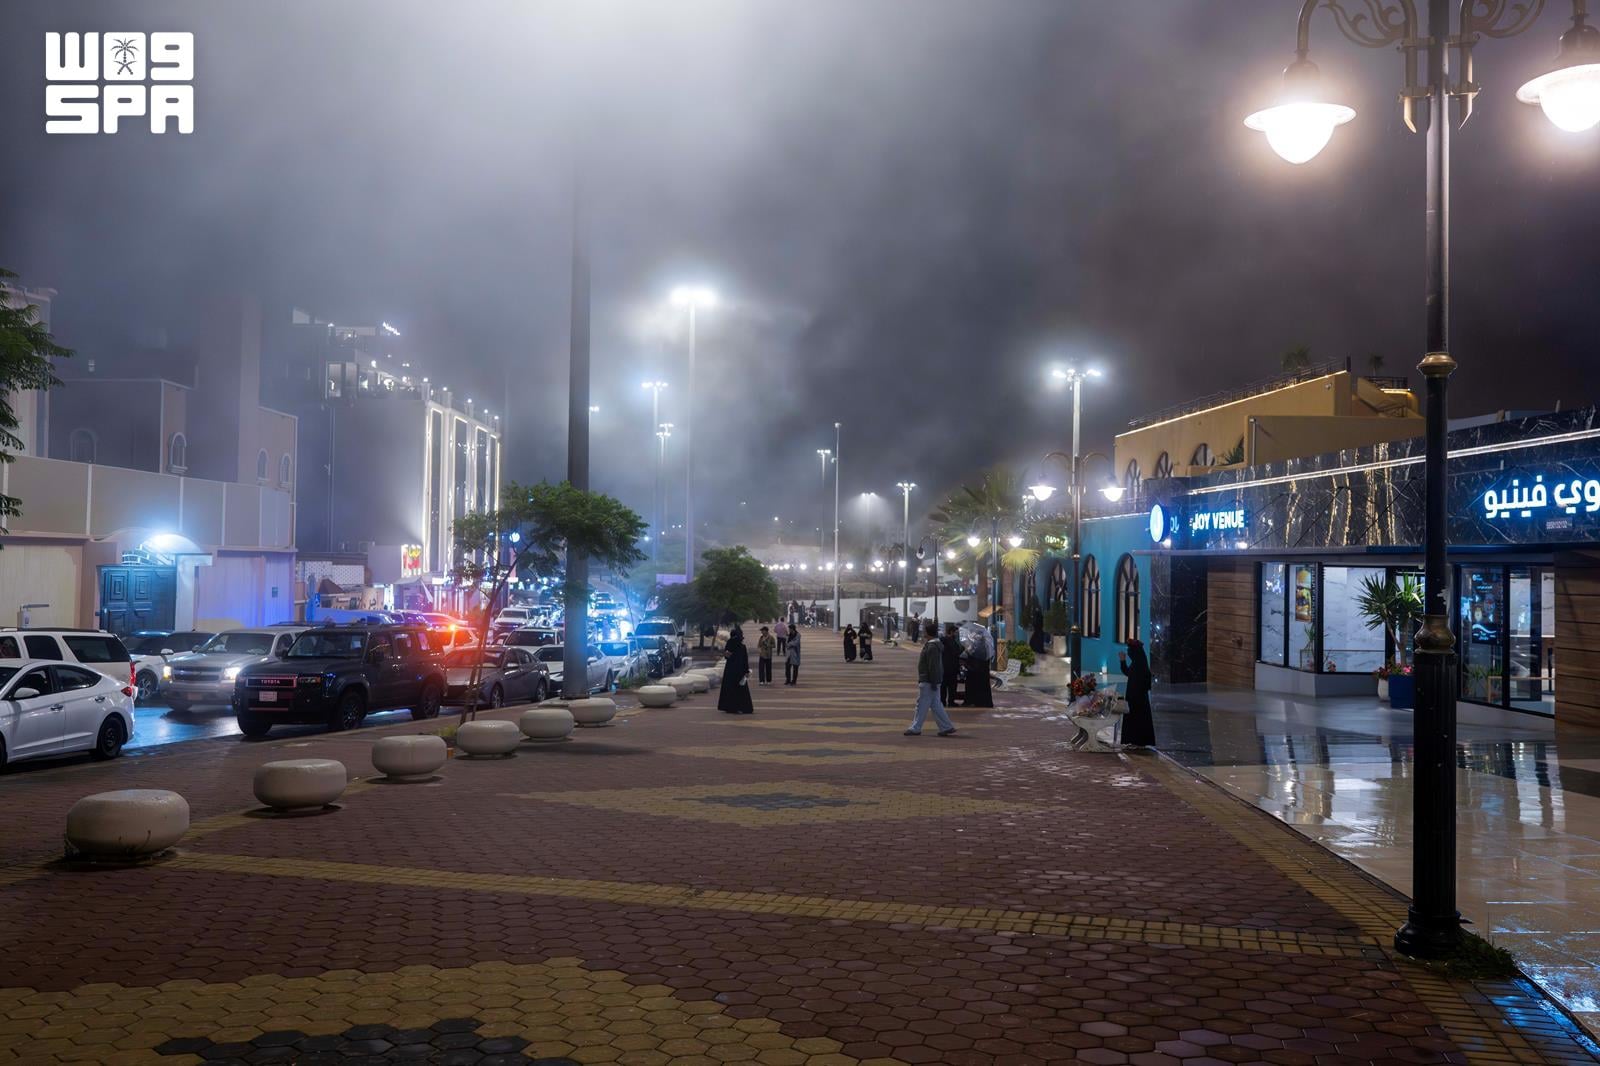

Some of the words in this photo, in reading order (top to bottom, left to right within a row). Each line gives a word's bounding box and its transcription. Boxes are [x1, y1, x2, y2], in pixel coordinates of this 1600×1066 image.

[1483, 474, 1547, 519] فينيو
[1553, 479, 1600, 514] وي
[1192, 512, 1211, 531] JOY
[1212, 510, 1245, 529] VENUE
